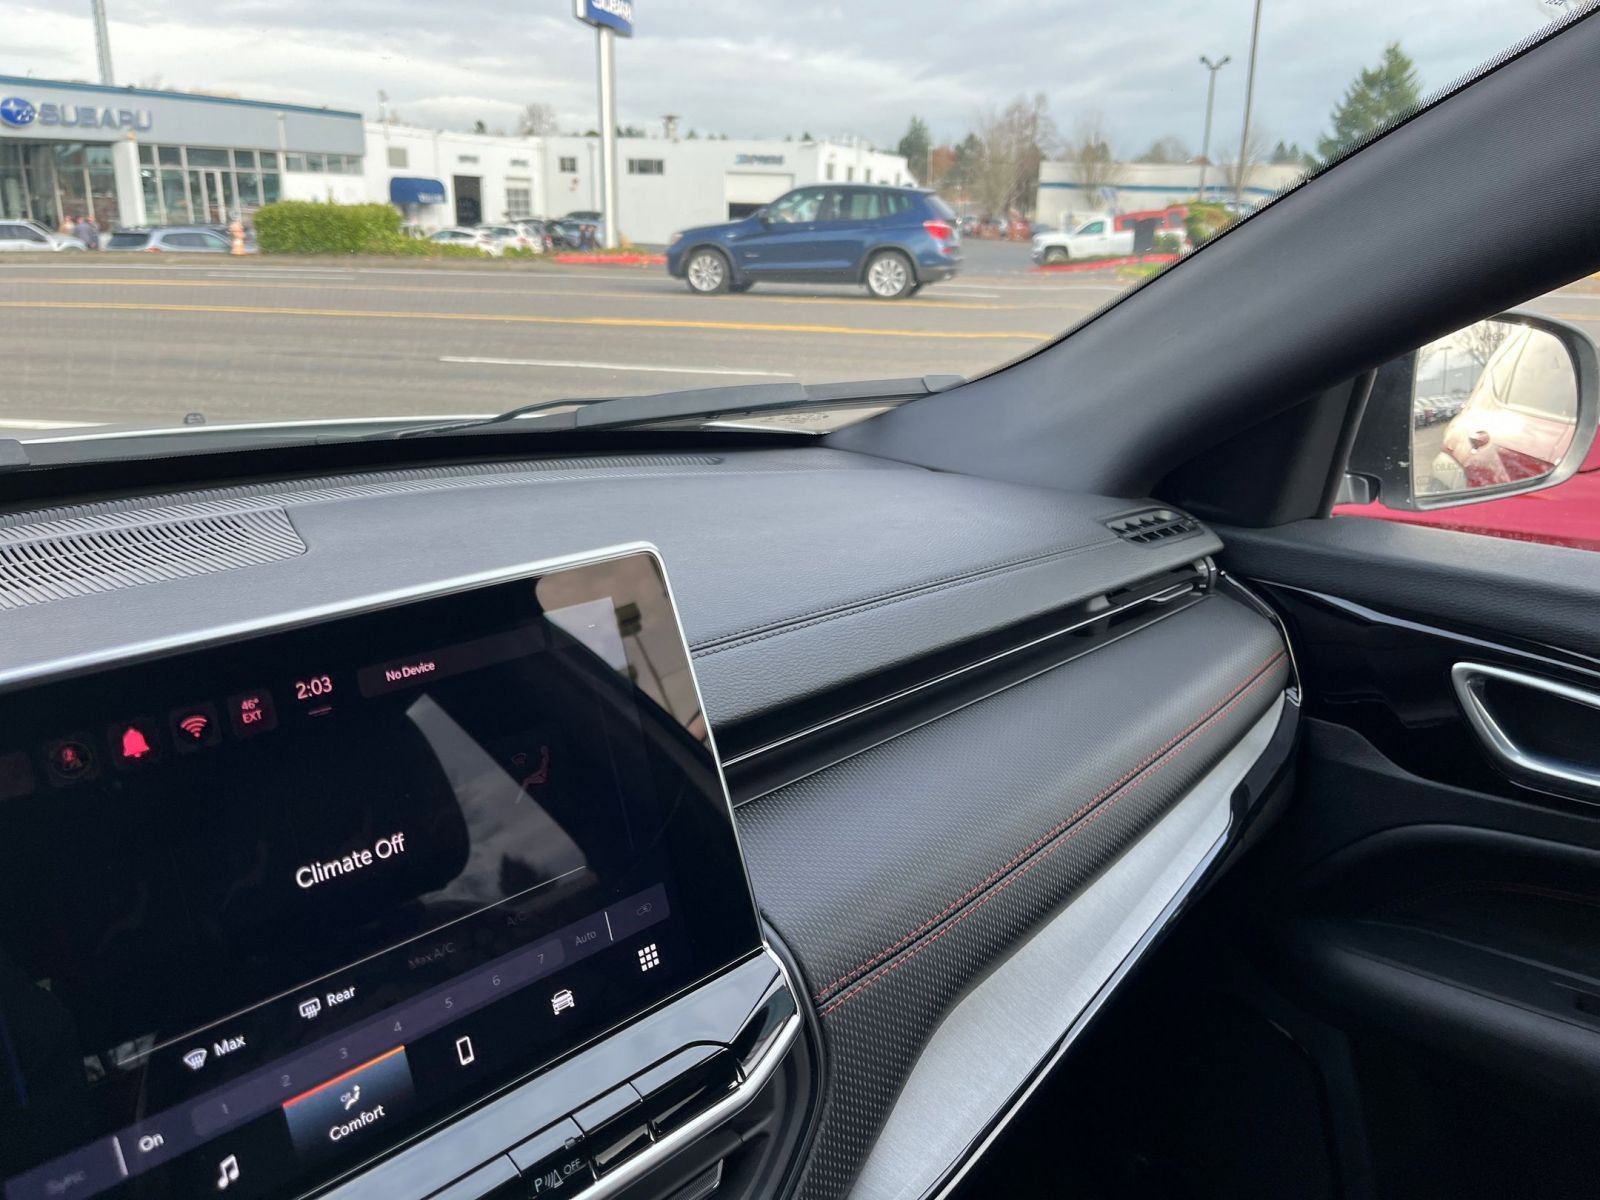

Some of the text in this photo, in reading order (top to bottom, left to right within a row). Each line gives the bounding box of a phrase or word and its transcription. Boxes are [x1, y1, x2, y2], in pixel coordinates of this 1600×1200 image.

[39, 103, 151, 131] SUBARU
[386, 661, 435, 682] No Device
[296, 675, 333, 700] 2:03
[242, 710, 262, 724] EXT
[296, 832, 405, 888] Climate Off
[327, 986, 356, 1007] Rear
[281, 1075, 291, 1087] 2
[339, 1047, 348, 1059] 3
[393, 1021, 403, 1032] 4
[445, 997, 454, 1009] 5
[492, 975, 501, 986] 6
[537, 953, 546, 965] 7
[575, 930, 597, 946] Auto
[213, 1035, 247, 1057] Max
[329, 1104, 386, 1141] Comfort
[139, 1132, 164, 1153] On
[563, 1158, 580, 1175] OFF
